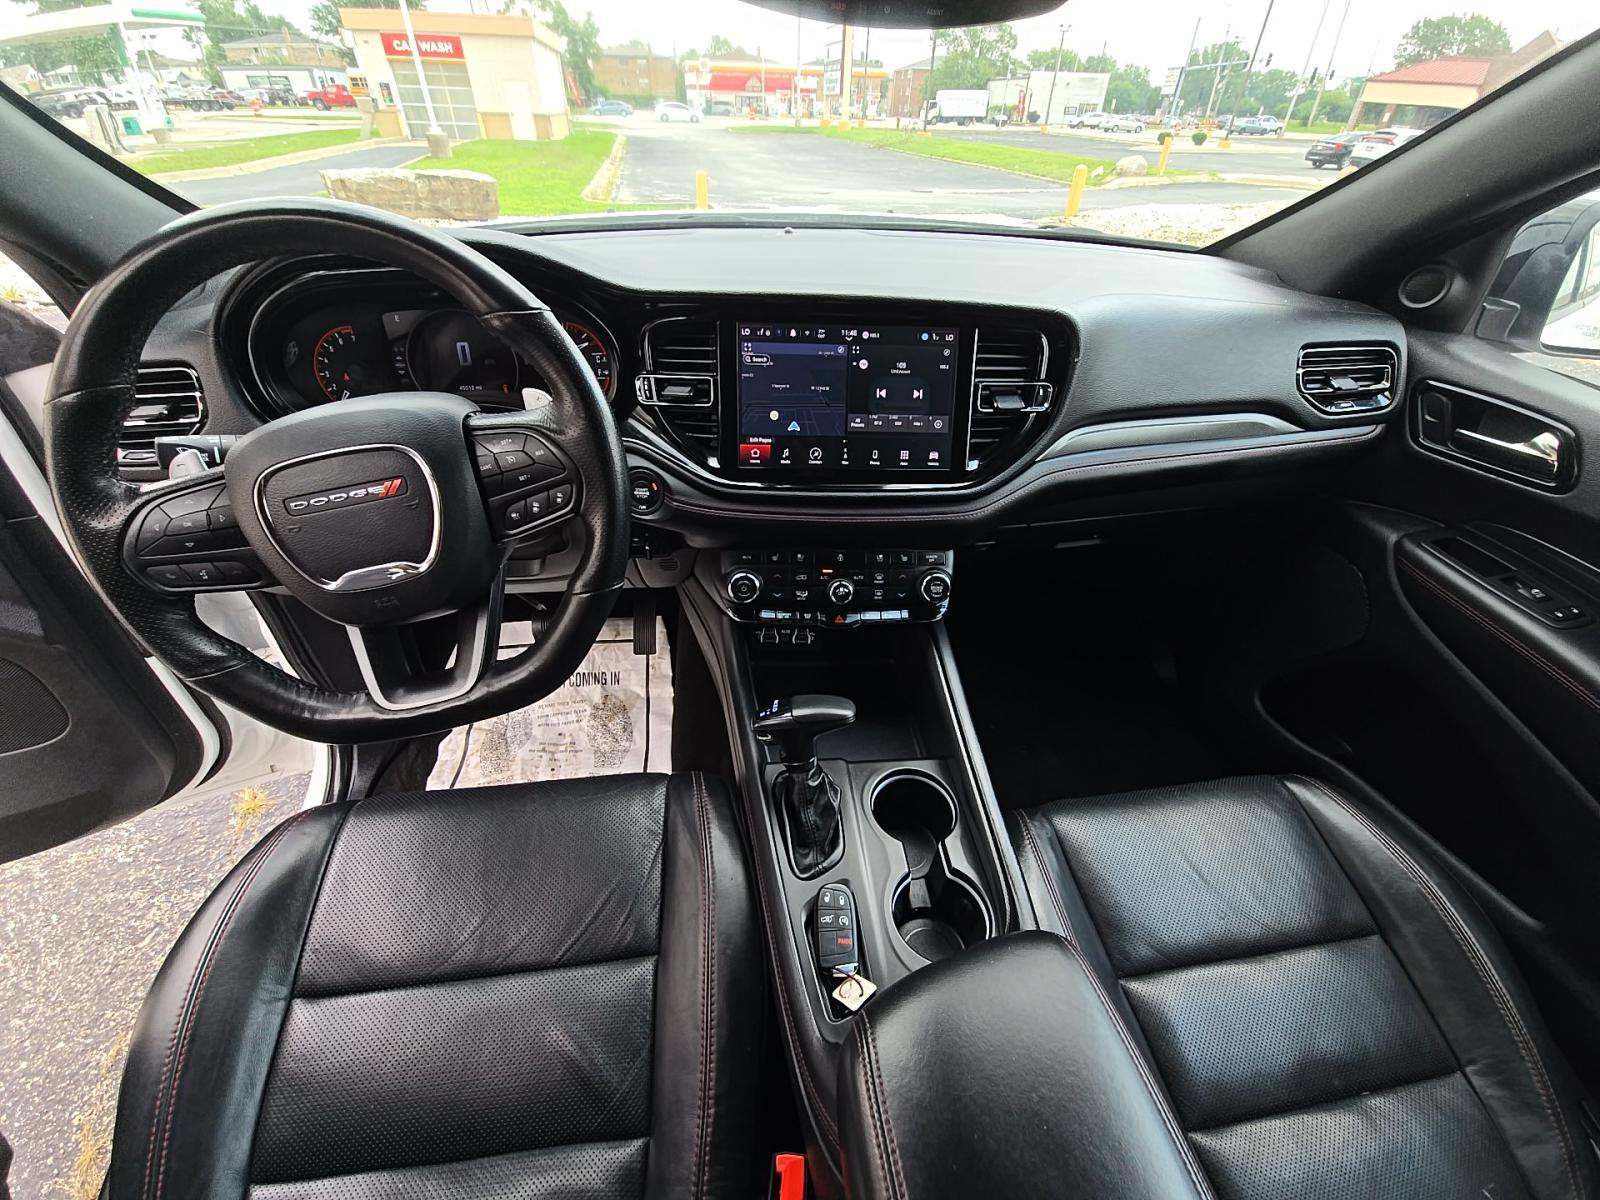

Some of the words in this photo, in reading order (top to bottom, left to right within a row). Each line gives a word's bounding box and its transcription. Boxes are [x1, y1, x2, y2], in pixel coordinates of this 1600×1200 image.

[392, 40, 414, 52] CA
[418, 41, 454, 54] WASH
[741, 328, 751, 336] LO
[456, 341, 472, 366] 0
[289, 485, 387, 510] DODGE
[569, 672, 607, 687] COMING
[610, 670, 620, 687] IN
